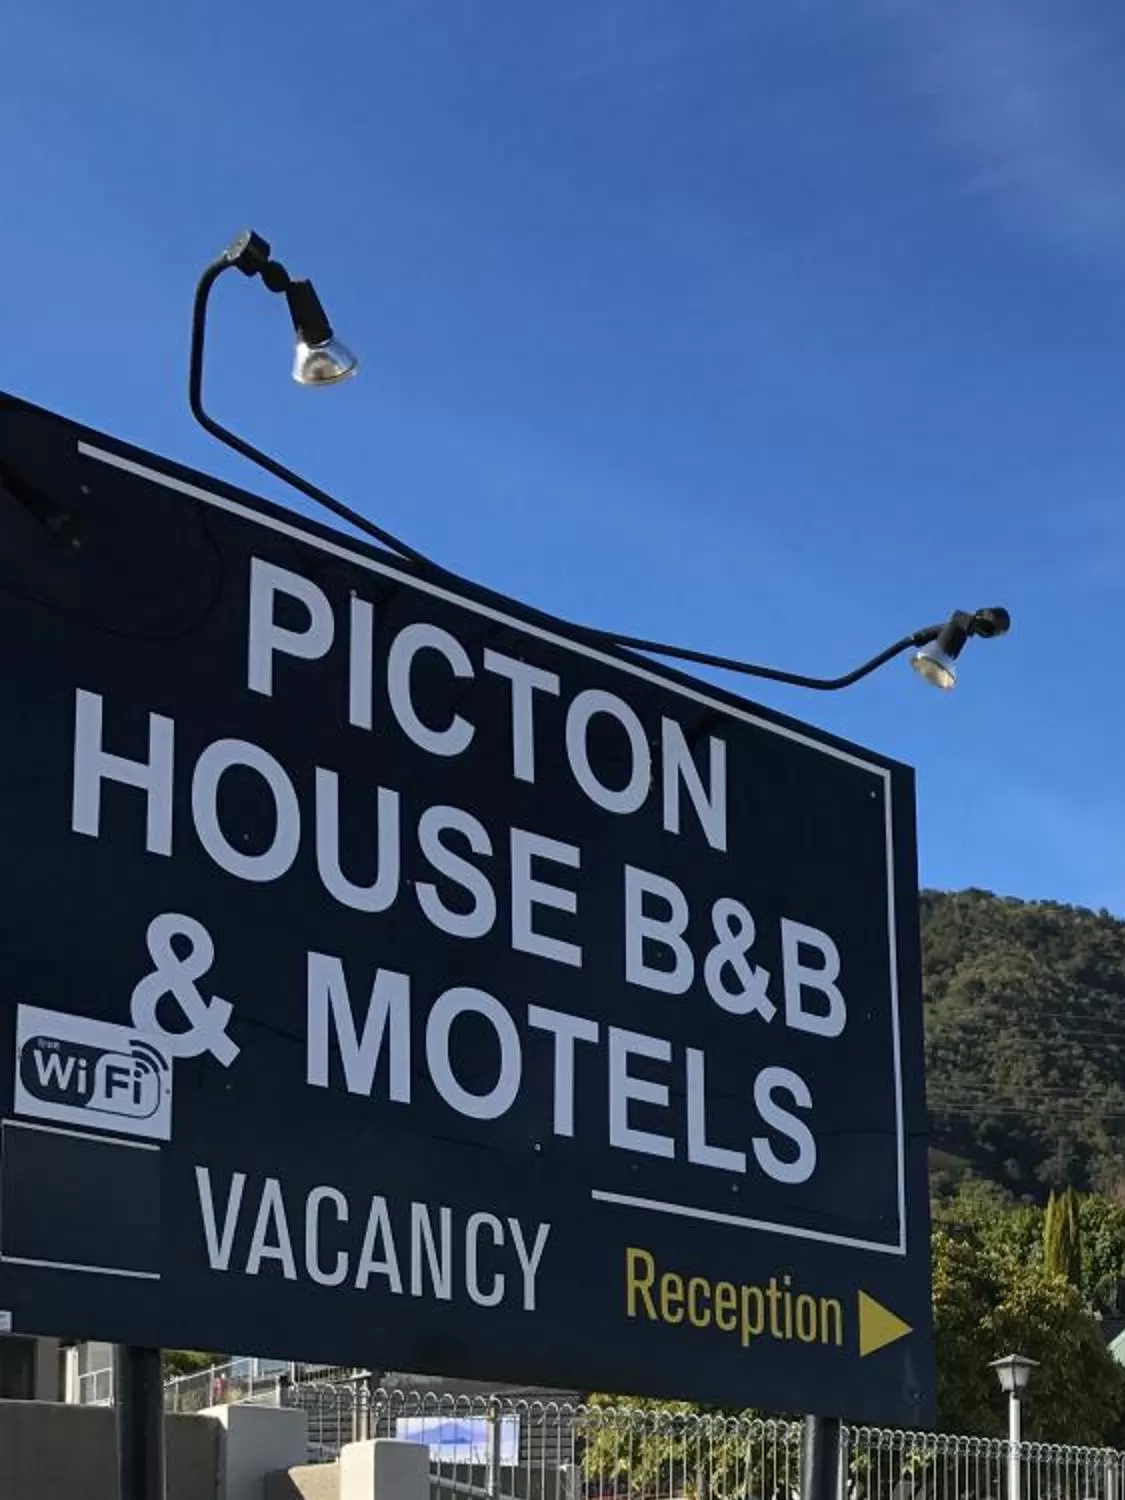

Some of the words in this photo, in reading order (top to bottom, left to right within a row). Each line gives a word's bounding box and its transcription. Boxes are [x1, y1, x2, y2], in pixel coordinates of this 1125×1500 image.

[248, 557, 727, 852] PICTON
[72, 688, 583, 967] HOUSE
[625, 865, 847, 1038] B&B
[130, 913, 240, 1068] &
[307, 951, 817, 1184] MOTELS
[196, 1166, 551, 1311] VACANCY
[626, 1247, 842, 1347] Reception
